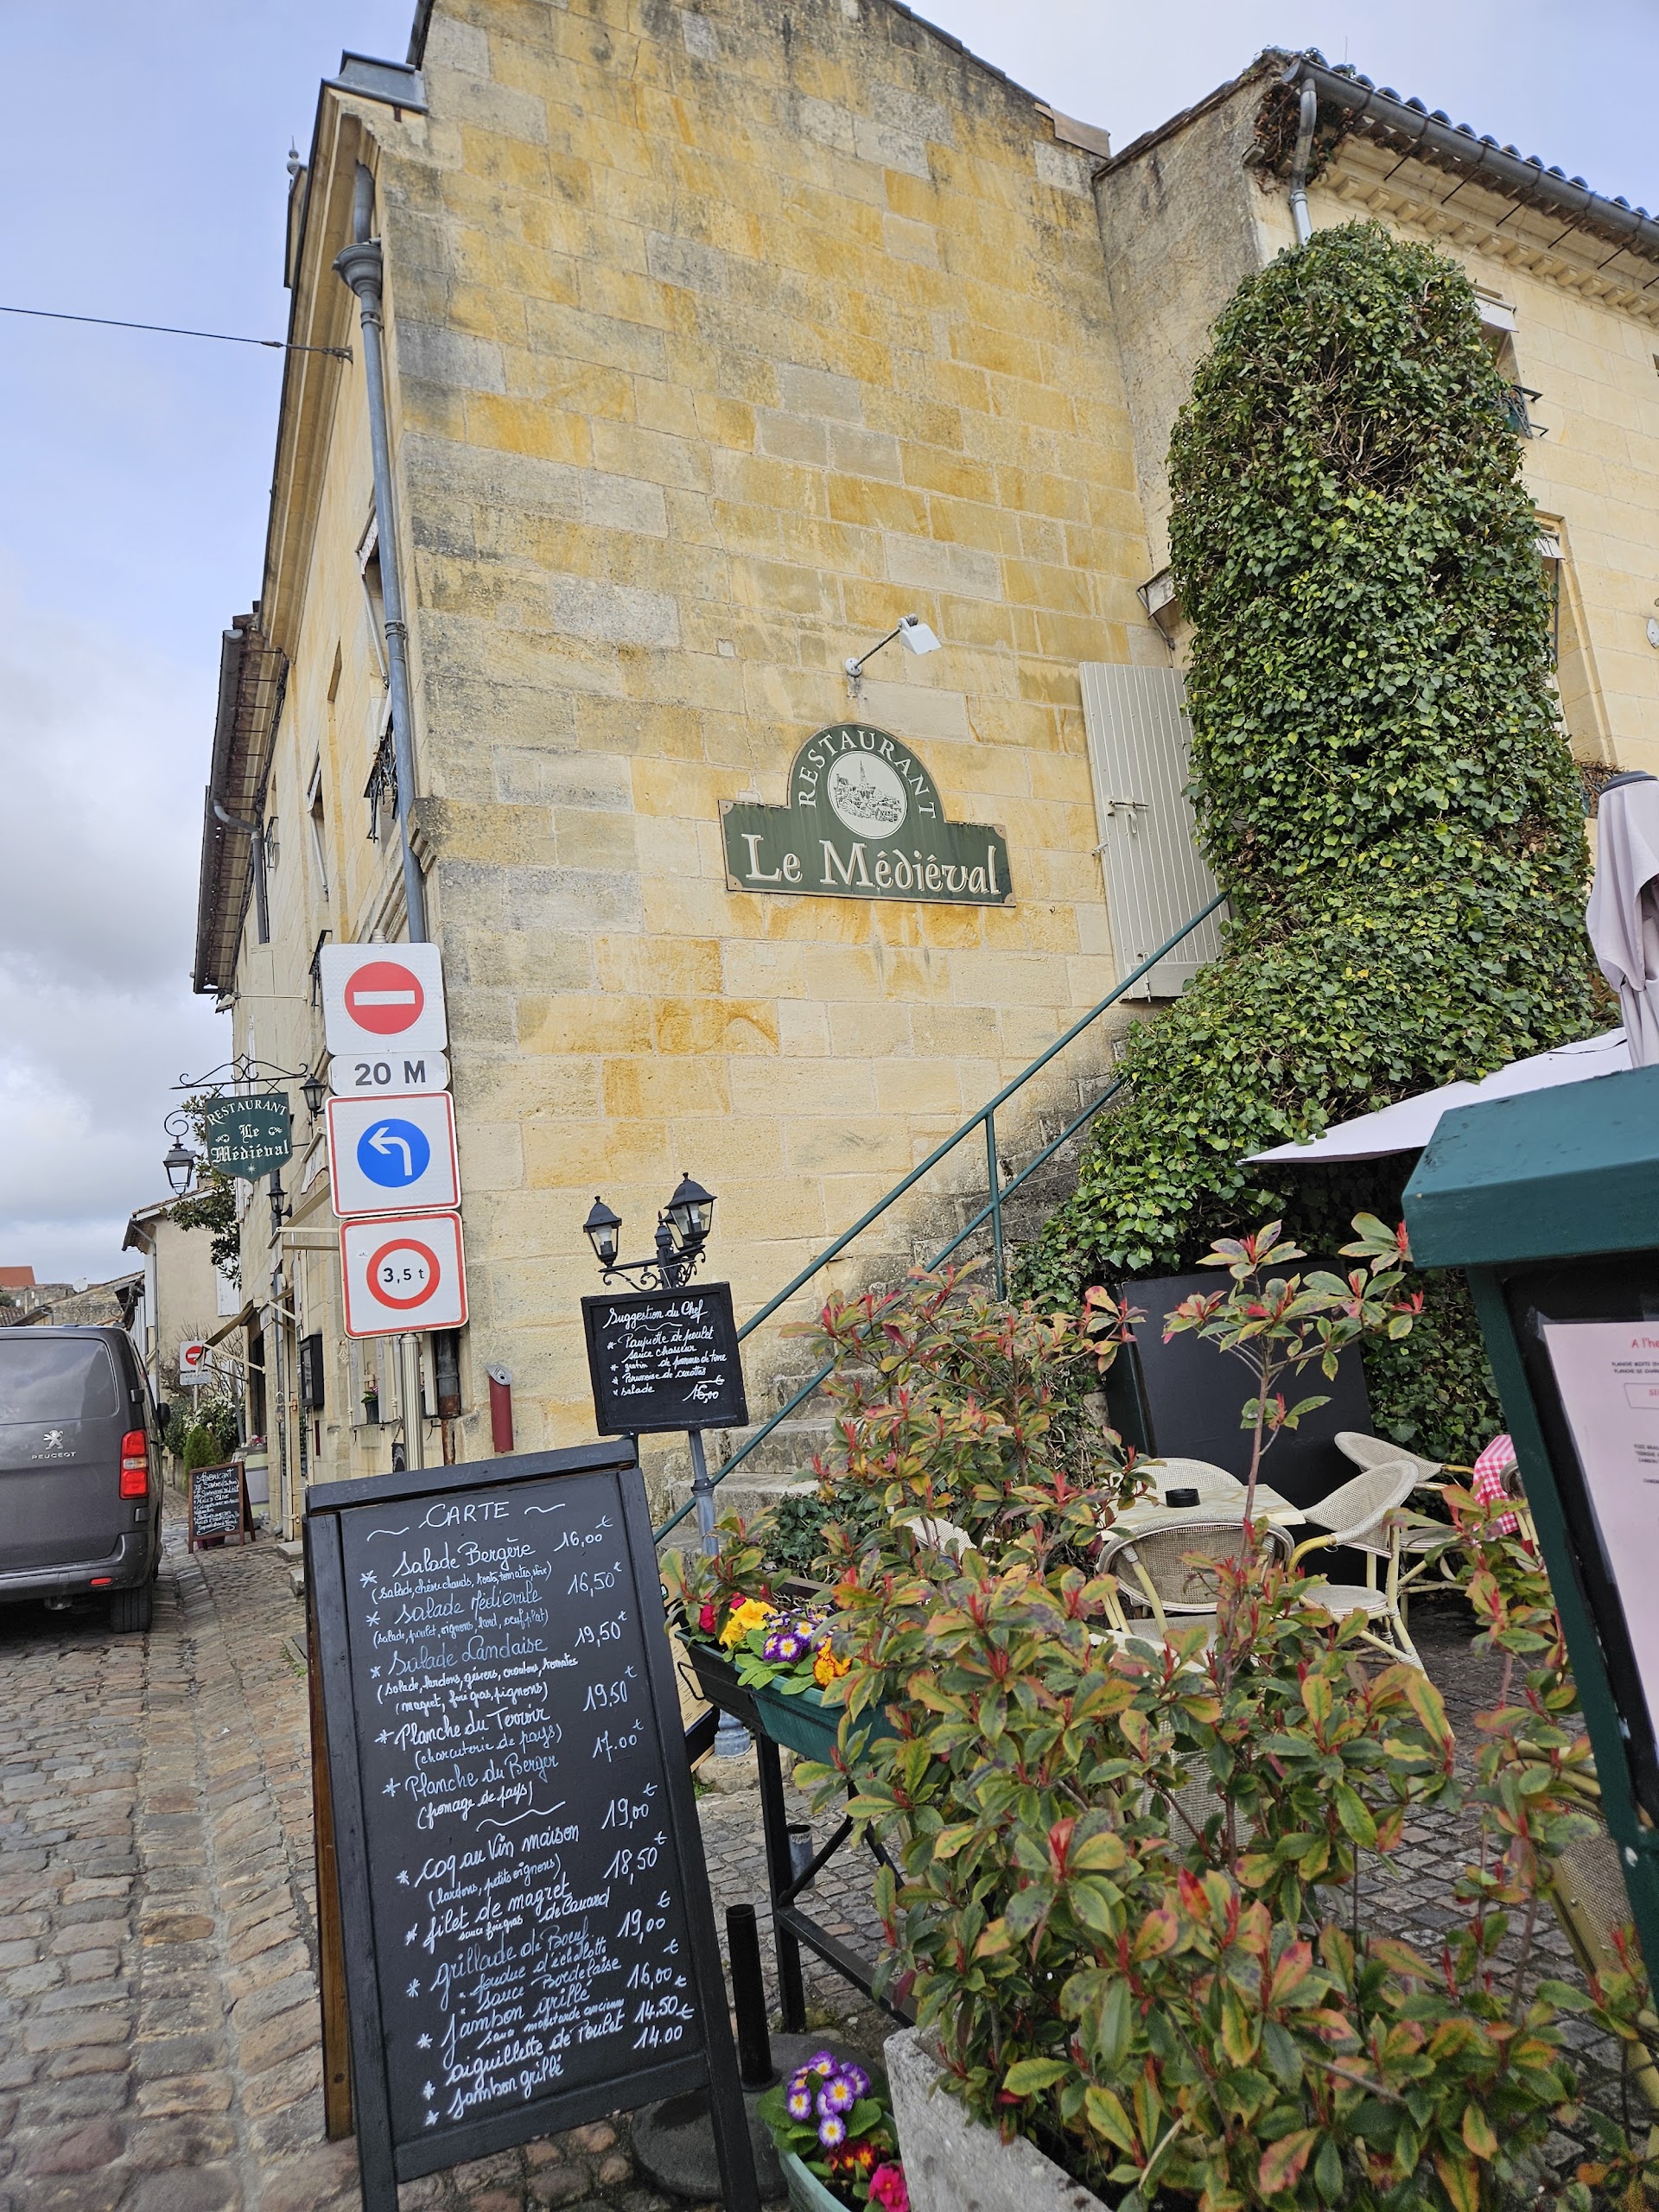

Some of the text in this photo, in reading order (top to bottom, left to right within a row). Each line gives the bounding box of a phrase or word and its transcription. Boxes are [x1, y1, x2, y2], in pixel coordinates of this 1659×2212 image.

[798, 729, 938, 819] RESTAURANT
[741, 833, 1001, 895] Le Médiéval
[354, 1060, 426, 1086] 20 M
[207, 1099, 288, 1126] RESTAURANT
[238, 1123, 260, 1144] Le
[210, 1139, 289, 1168] Médiéval
[383, 1267, 425, 1284] 3,5 t
[602, 1299, 709, 1330] Suggestion du Chef
[669, 1328, 683, 1343] de
[682, 1325, 715, 1347] poulet
[1631, 1338, 1639, 1349] A
[621, 1348, 654, 1363] sauce
[658, 1357, 671, 1367] de
[700, 1350, 709, 1363] de
[660, 1367, 674, 1380] de
[620, 1382, 656, 1396] salade
[31, 1452, 77, 1460] PEUGEOT
[419, 1501, 510, 1529] CARTE
[457, 1537, 537, 1570] Bergère
[461, 1631, 549, 1663] Landaise
[393, 1710, 462, 1751] Planche
[464, 1708, 487, 1734] du
[485, 1702, 551, 1729] Terroir
[495, 1731, 517, 1751] de
[405, 1763, 479, 1802] Planche
[481, 1758, 505, 1783] du
[503, 1751, 560, 1783] Berger
[474, 1787, 498, 1806] de
[458, 1847, 486, 1870] au
[521, 1823, 581, 1853] maison
[474, 1897, 504, 1923] de
[506, 1871, 574, 1916] magret
[538, 1901, 563, 1923] de
[520, 1928, 543, 1957] de
[476, 1955, 622, 2013] sauce Bordelaise
[532, 1979, 591, 2023] grillé
[549, 2026, 573, 2051] de
[519, 2053, 565, 2100] grillé
